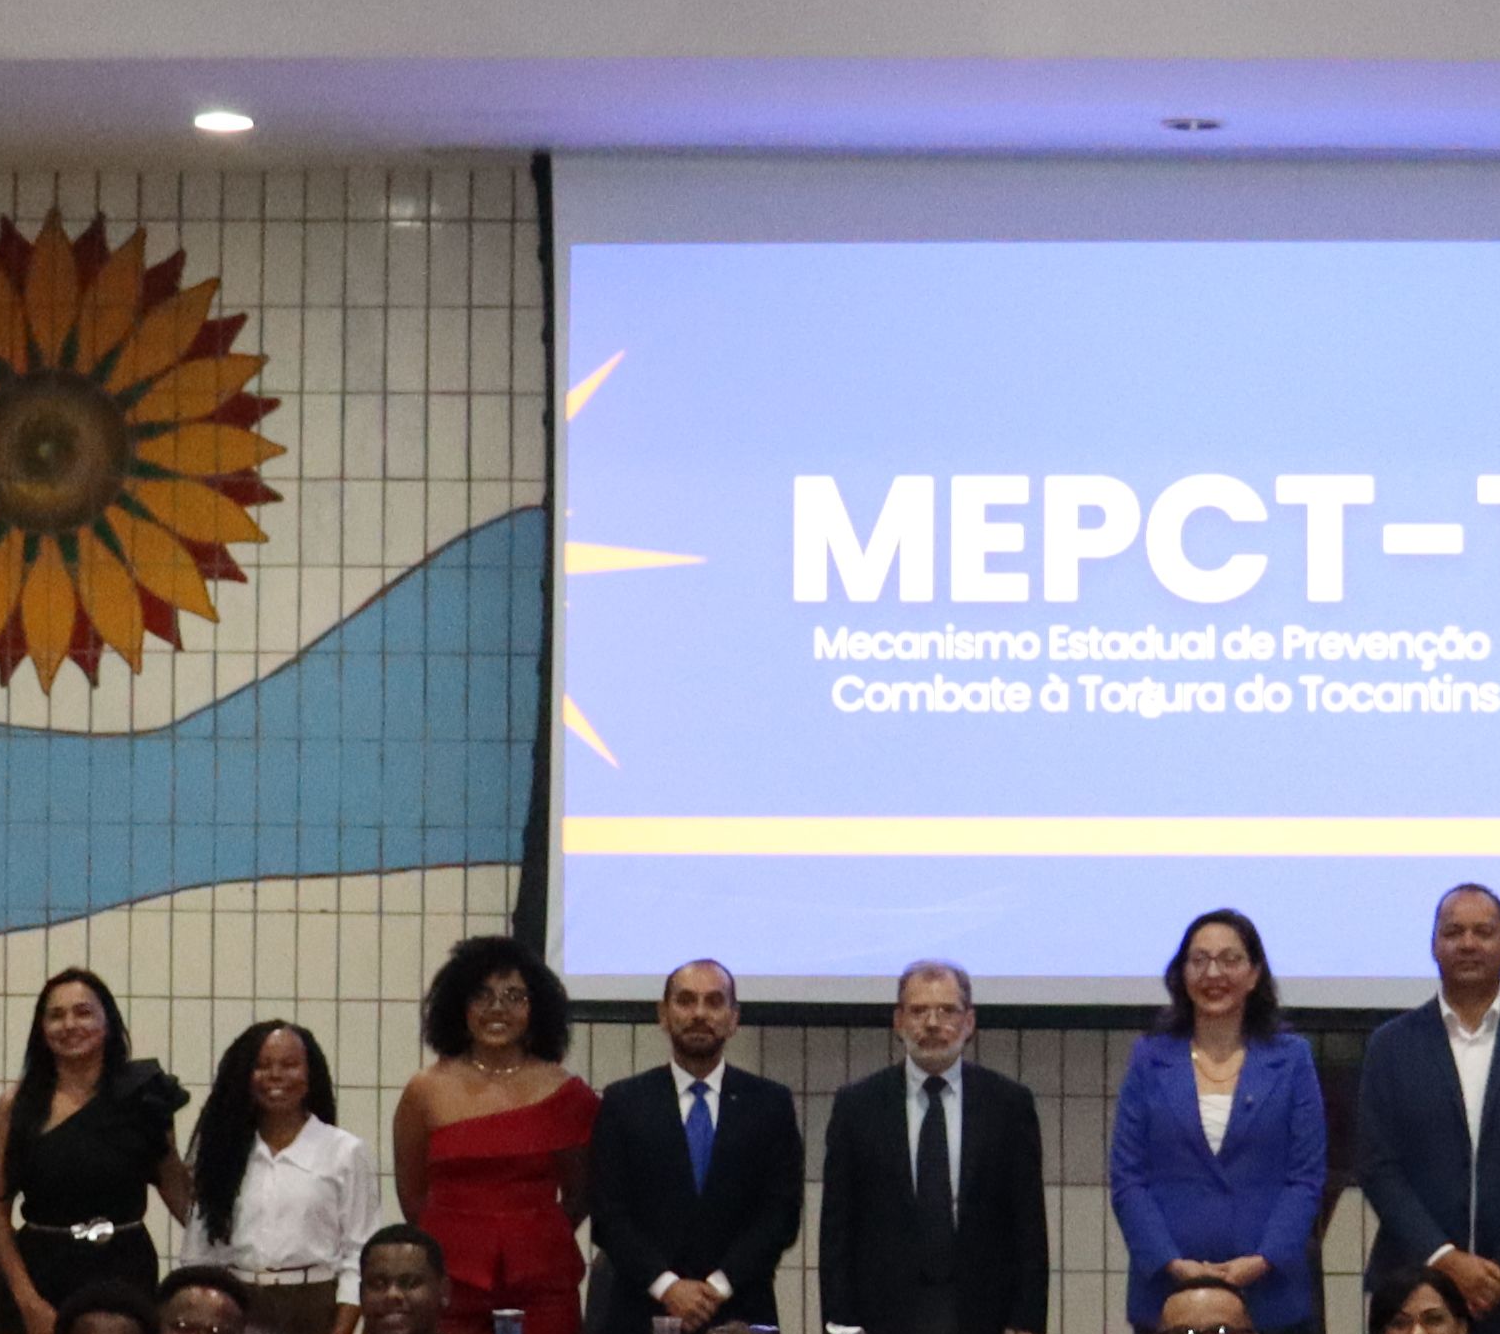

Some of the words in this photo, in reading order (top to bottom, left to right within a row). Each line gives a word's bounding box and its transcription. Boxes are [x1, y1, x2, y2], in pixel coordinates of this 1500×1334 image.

[813, 623, 1041, 660] Mecanismo
[1048, 624, 1215, 660] Estadual
[1222, 624, 1276, 660] de
[1283, 624, 1491, 671] Prevenção
[832, 673, 1032, 712] Combate
[1039, 672, 1070, 712] à
[1234, 673, 1293, 713] do
